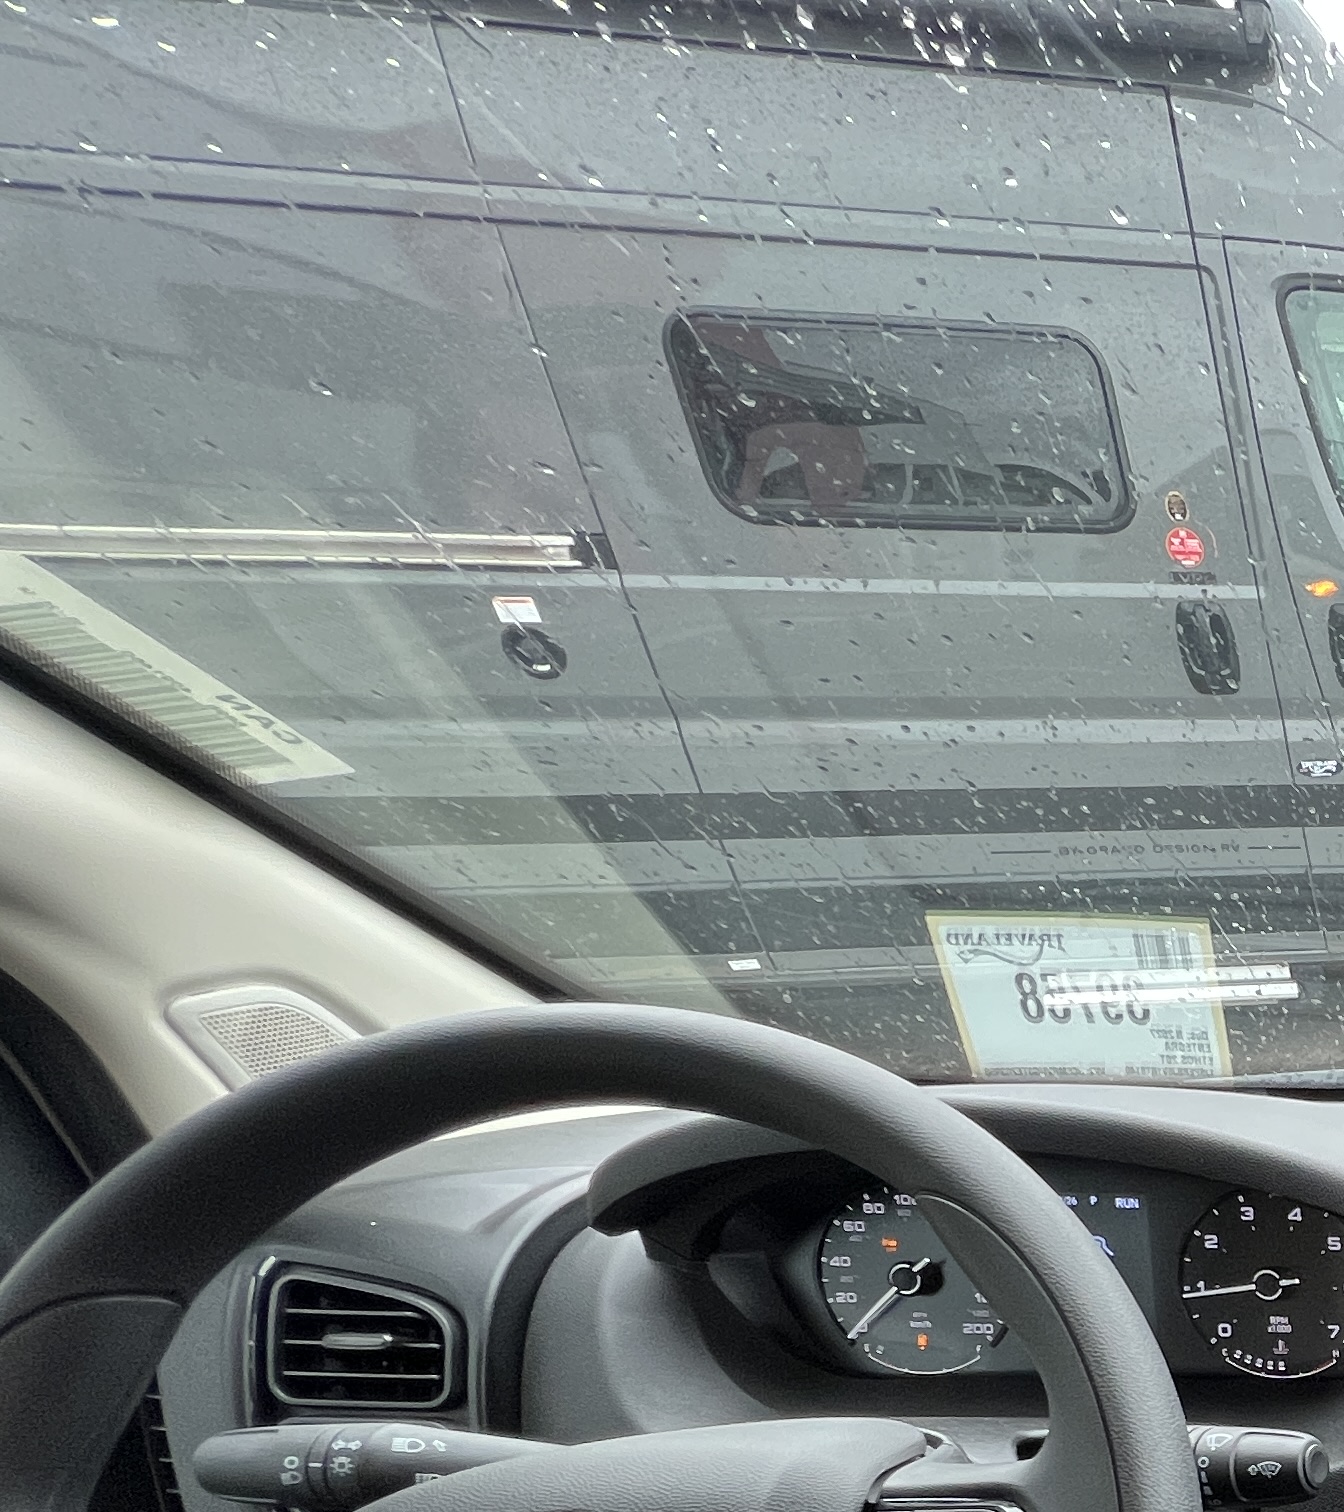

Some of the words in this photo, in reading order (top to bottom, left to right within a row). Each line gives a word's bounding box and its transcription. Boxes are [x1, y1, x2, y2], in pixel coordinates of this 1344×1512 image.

[863, 1202, 885, 1215] 80
[1089, 1196, 1099, 1206] P
[1114, 1196, 1141, 1209] RUN
[1240, 1205, 1255, 1221] 3
[1287, 1207, 1303, 1222] 4
[843, 1220, 866, 1232] 60
[1203, 1233, 1219, 1249] 2
[1327, 1236, 1342, 1251] 5
[829, 1255, 852, 1267] 40
[1196, 1280, 1206, 1293] 1
[835, 1292, 858, 1304] 20
[962, 1323, 994, 1335] 200
[1217, 1323, 1232, 1338] 0
[1326, 1324, 1341, 1339] 7
